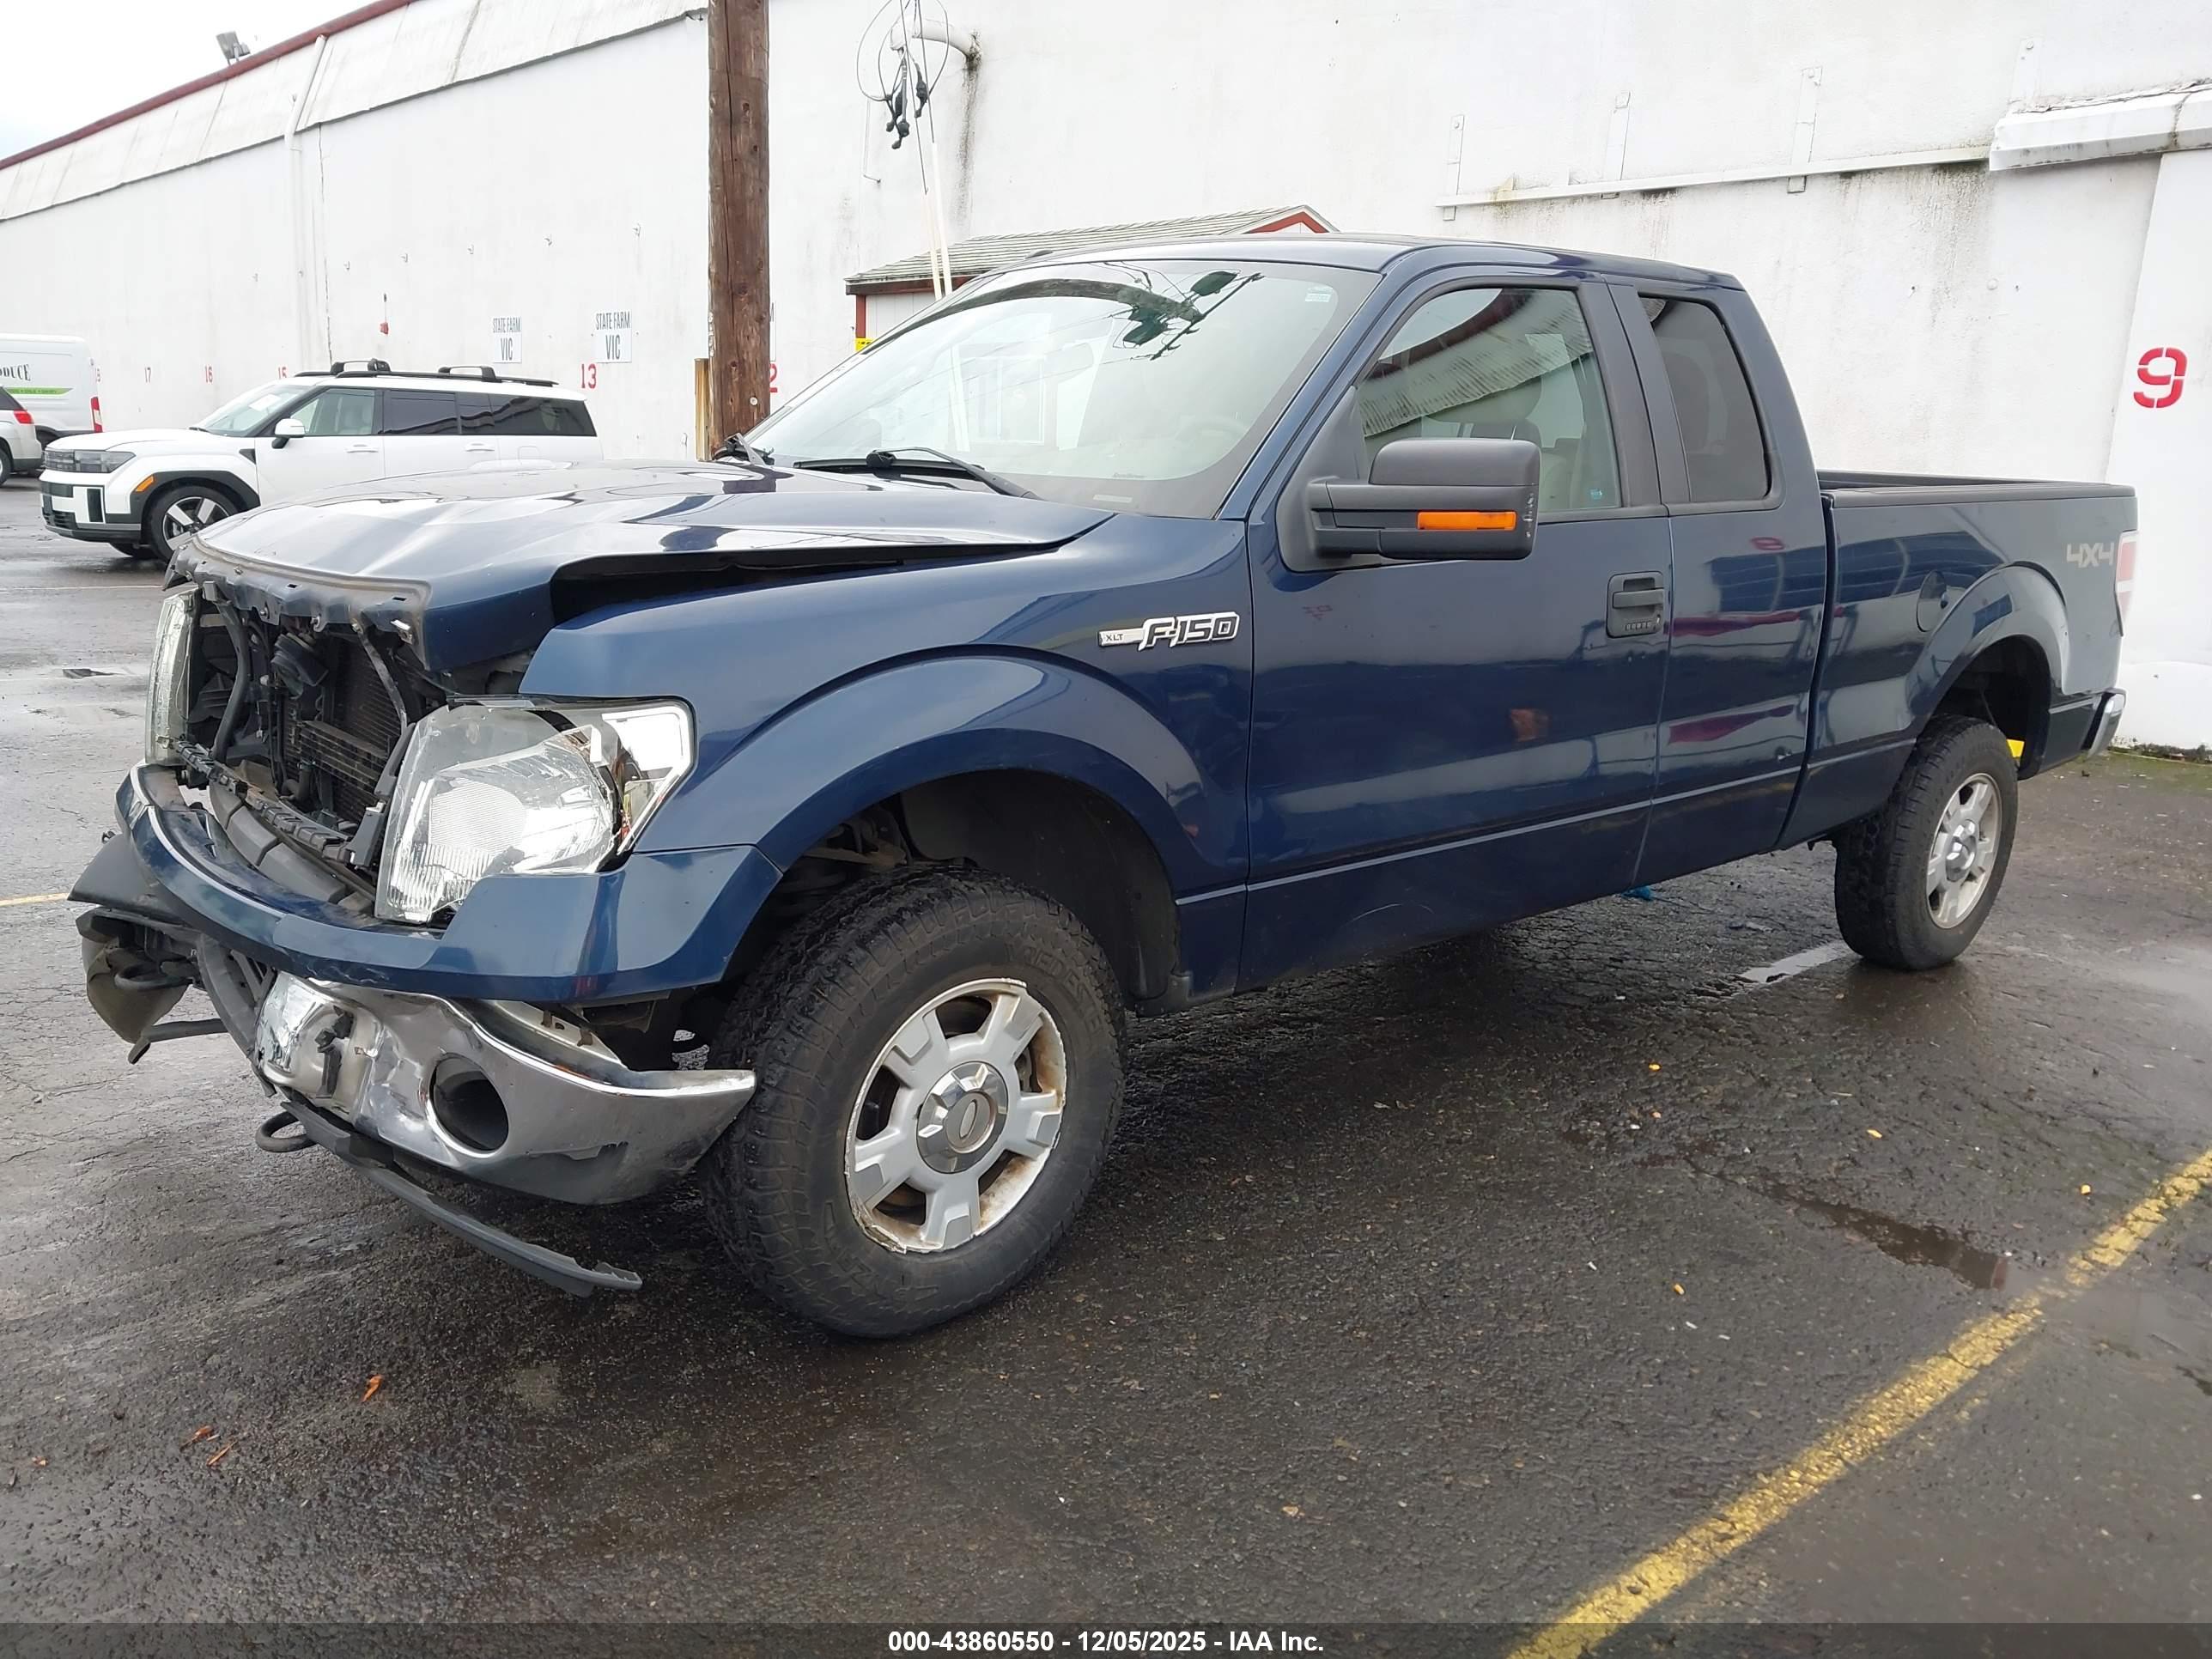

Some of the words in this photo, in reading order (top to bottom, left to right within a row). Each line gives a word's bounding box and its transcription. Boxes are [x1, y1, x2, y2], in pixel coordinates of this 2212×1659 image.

[493, 318, 506, 333] STATE
[507, 316, 520, 333] FARM
[596, 312, 612, 331] STATE
[613, 311, 630, 330] FARM
[500, 337, 514, 361] VIC
[605, 334, 621, 360] VIC
[0, 363, 31, 381] DUCE
[144, 367, 152, 383] 17
[204, 365, 213, 383] 16
[581, 363, 597, 389] 13
[2133, 347, 2188, 409] 9
[1105, 633, 1123, 642] XLT
